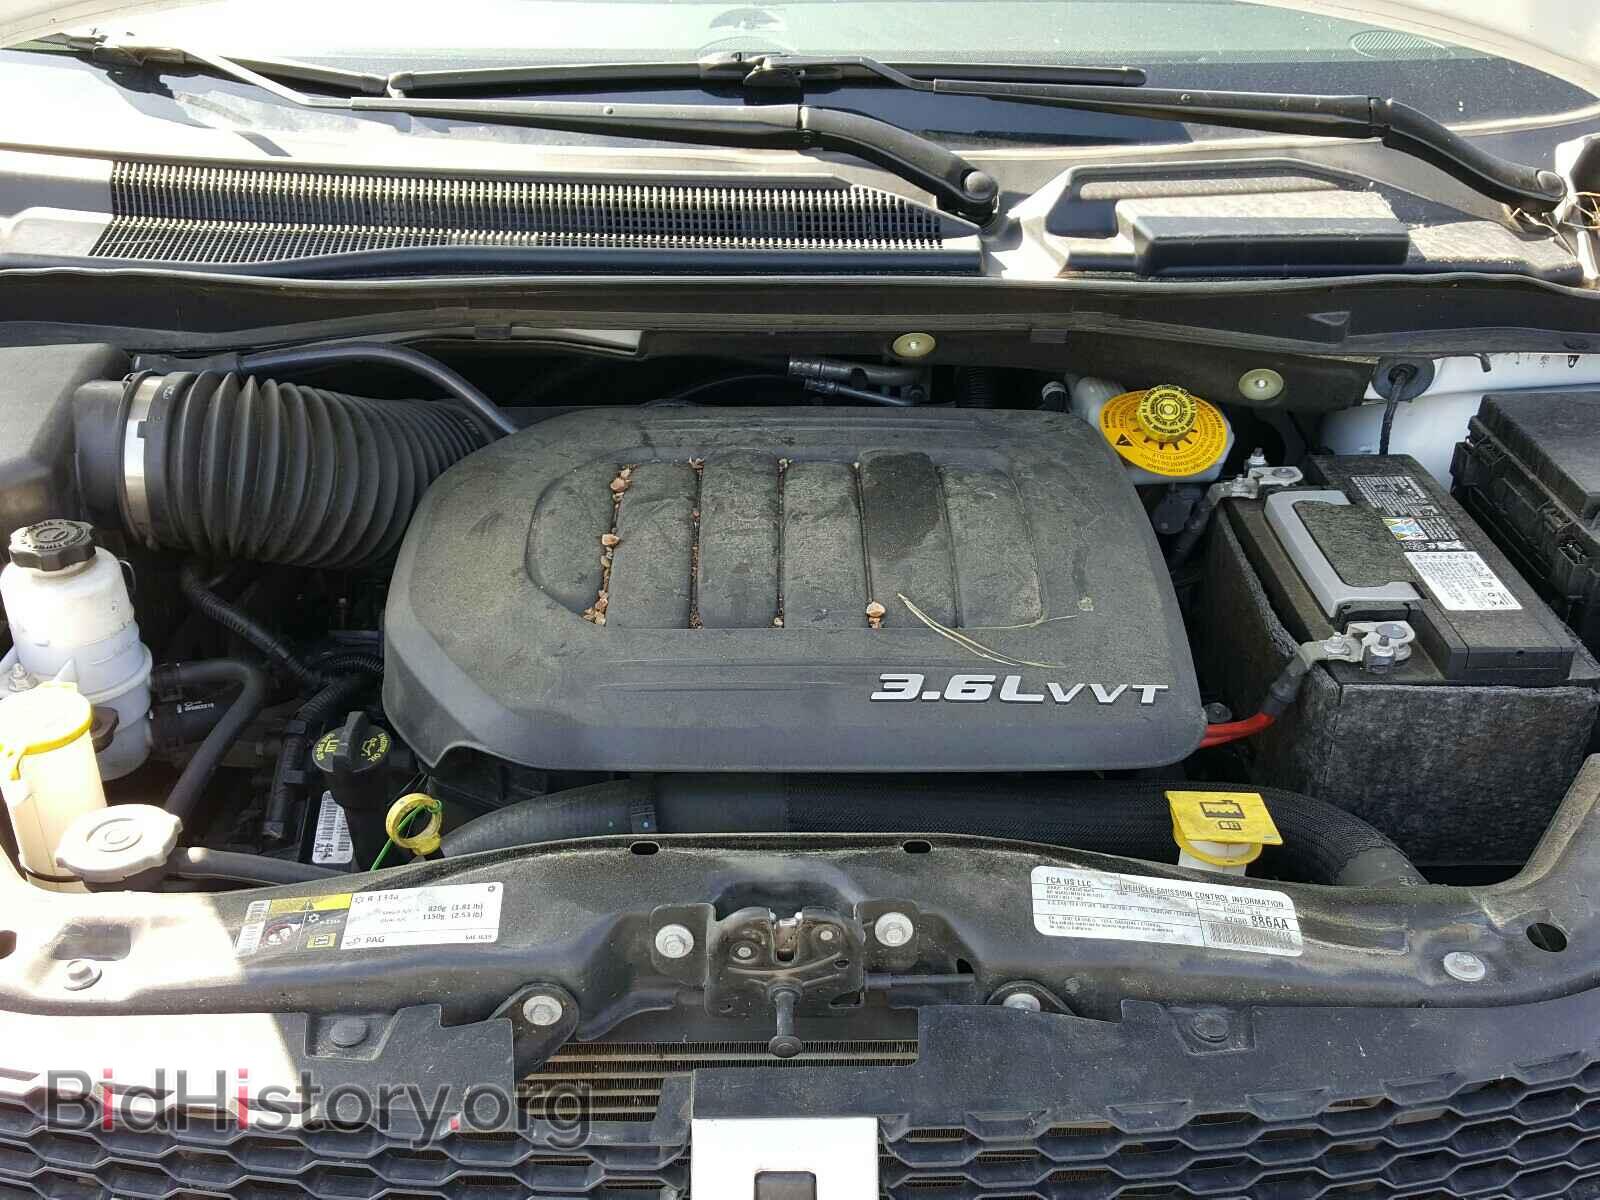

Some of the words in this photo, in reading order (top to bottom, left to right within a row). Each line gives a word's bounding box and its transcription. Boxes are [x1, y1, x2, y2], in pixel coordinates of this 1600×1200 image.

[870, 673, 1045, 702] 3.6L
[1047, 682, 1169, 704] VVT
[1046, 876, 1061, 884] FCA
[1063, 878, 1075, 886] US
[1077, 879, 1092, 887] LLC
[1123, 882, 1154, 894] VEHICLE
[1195, 891, 1229, 903] CONTROL
[1231, 895, 1284, 909] INFORMATION
[428, 904, 447, 912] 820g
[423, 912, 446, 920] 1150g
